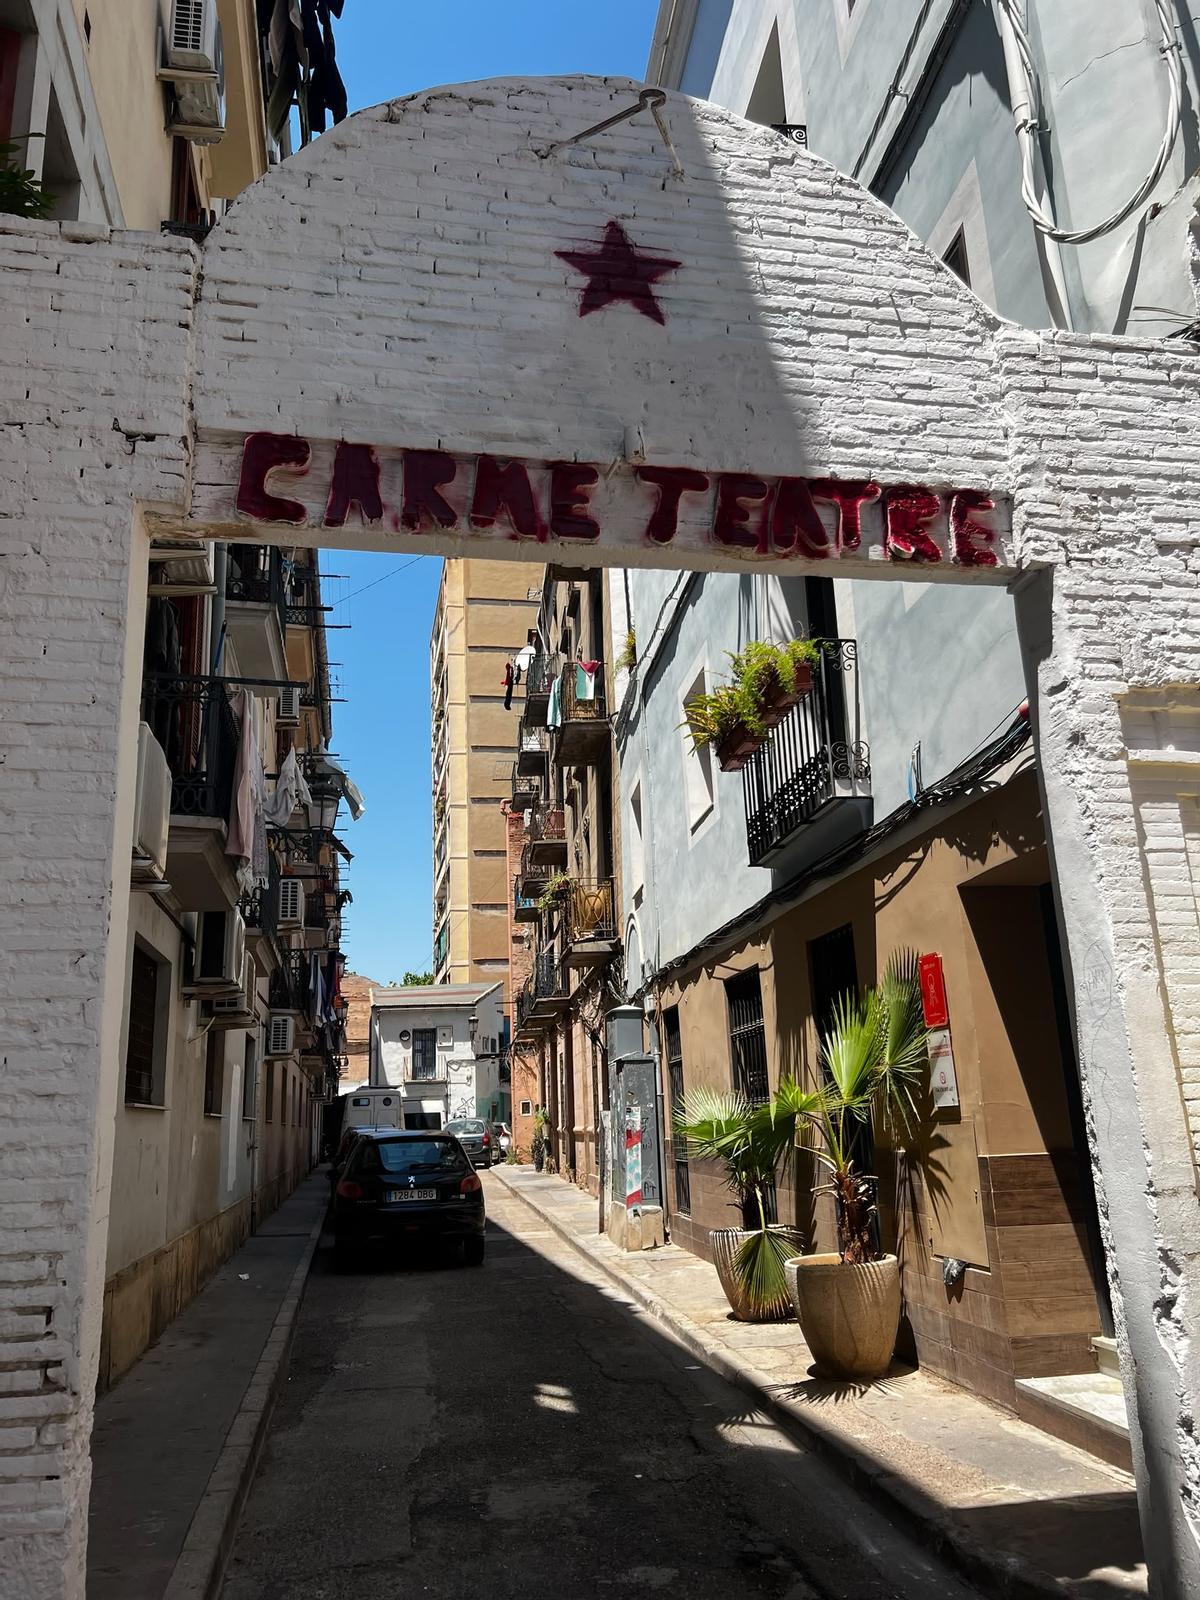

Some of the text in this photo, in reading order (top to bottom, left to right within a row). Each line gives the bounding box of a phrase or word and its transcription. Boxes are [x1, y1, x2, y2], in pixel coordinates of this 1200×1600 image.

[236, 432, 998, 566] CARME TEATRE
[394, 1190, 415, 1200] 1284
